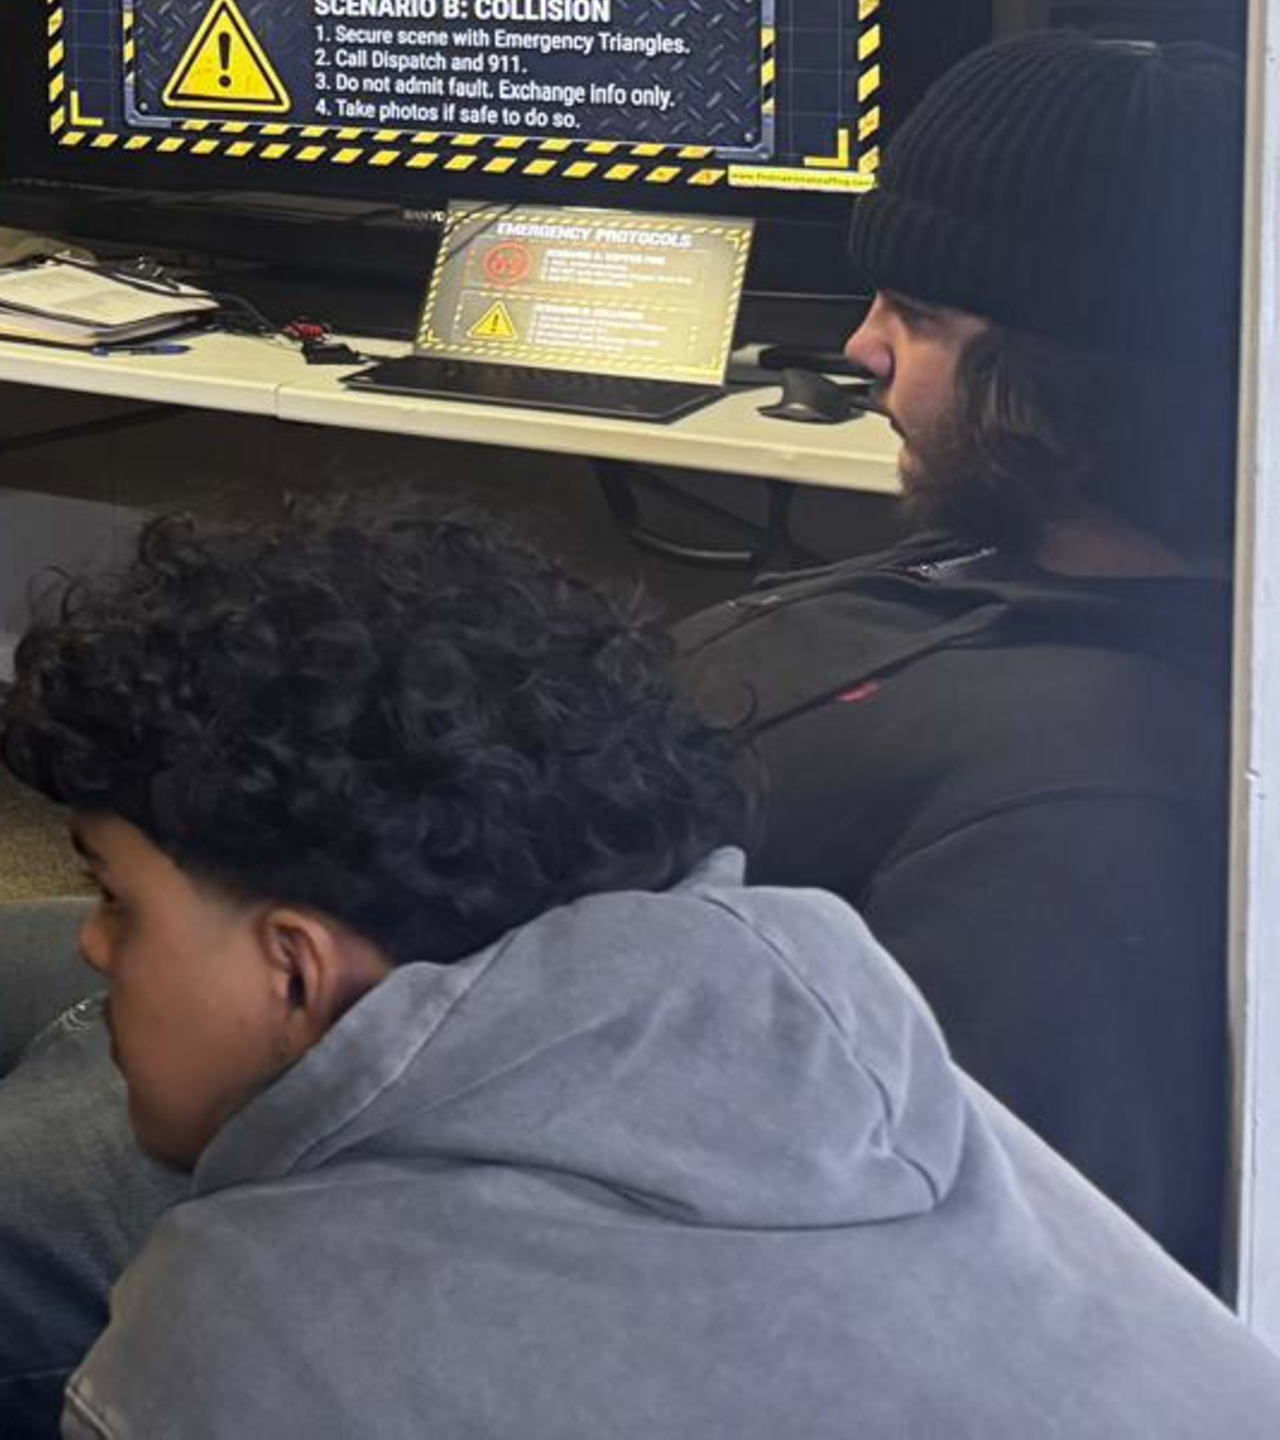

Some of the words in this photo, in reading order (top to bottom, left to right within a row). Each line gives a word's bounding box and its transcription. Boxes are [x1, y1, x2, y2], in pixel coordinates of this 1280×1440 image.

[314, 25, 331, 42] 1.
[335, 25, 392, 44] Secure
[397, 30, 448, 46] scene
[453, 29, 489, 47] with
[494, 29, 594, 55] Emergency
[598, 31, 690, 56] Triangles.
[315, 48, 331, 66] 2.
[335, 50, 366, 68] Call
[372, 51, 445, 72] Dispatch
[451, 53, 483, 72] and
[487, 54, 527, 74] 911.
[315, 72, 331, 90] 3.
[336, 74, 358, 91] Do
[363, 76, 390, 92] not
[395, 76, 443, 95] admit
[448, 76, 493, 98] fault.
[499, 79, 585, 106] Exchange
[590, 83, 626, 104] info
[631, 84, 675, 110] only.
[315, 99, 331, 116] 4.
[335, 99, 375, 118] Take
[379, 101, 438, 122] photos
[443, 103, 456, 121] if
[459, 104, 497, 124] safe
[502, 107, 520, 125] to
[524, 107, 548, 126] do
[552, 112, 580, 128] so.
